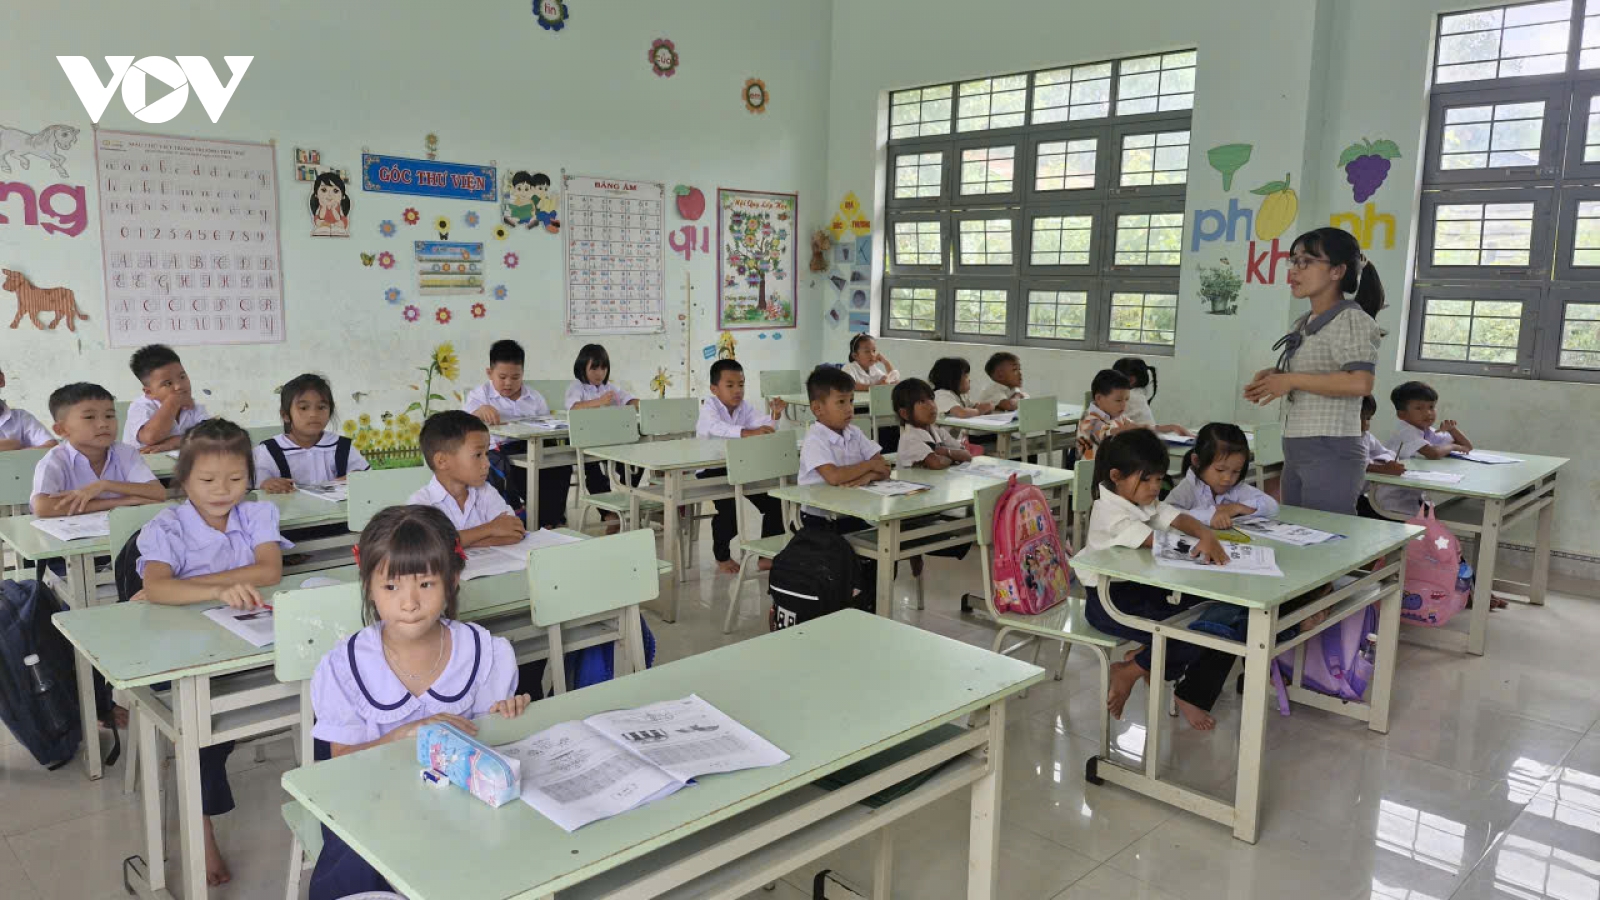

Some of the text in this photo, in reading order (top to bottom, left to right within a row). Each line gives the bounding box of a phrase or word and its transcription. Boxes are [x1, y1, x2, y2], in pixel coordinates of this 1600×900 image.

[379, 164, 486, 194] GÓC THƯ VIỆN
[1191, 198, 1253, 251] ph
[1246, 238, 1293, 284] kh
